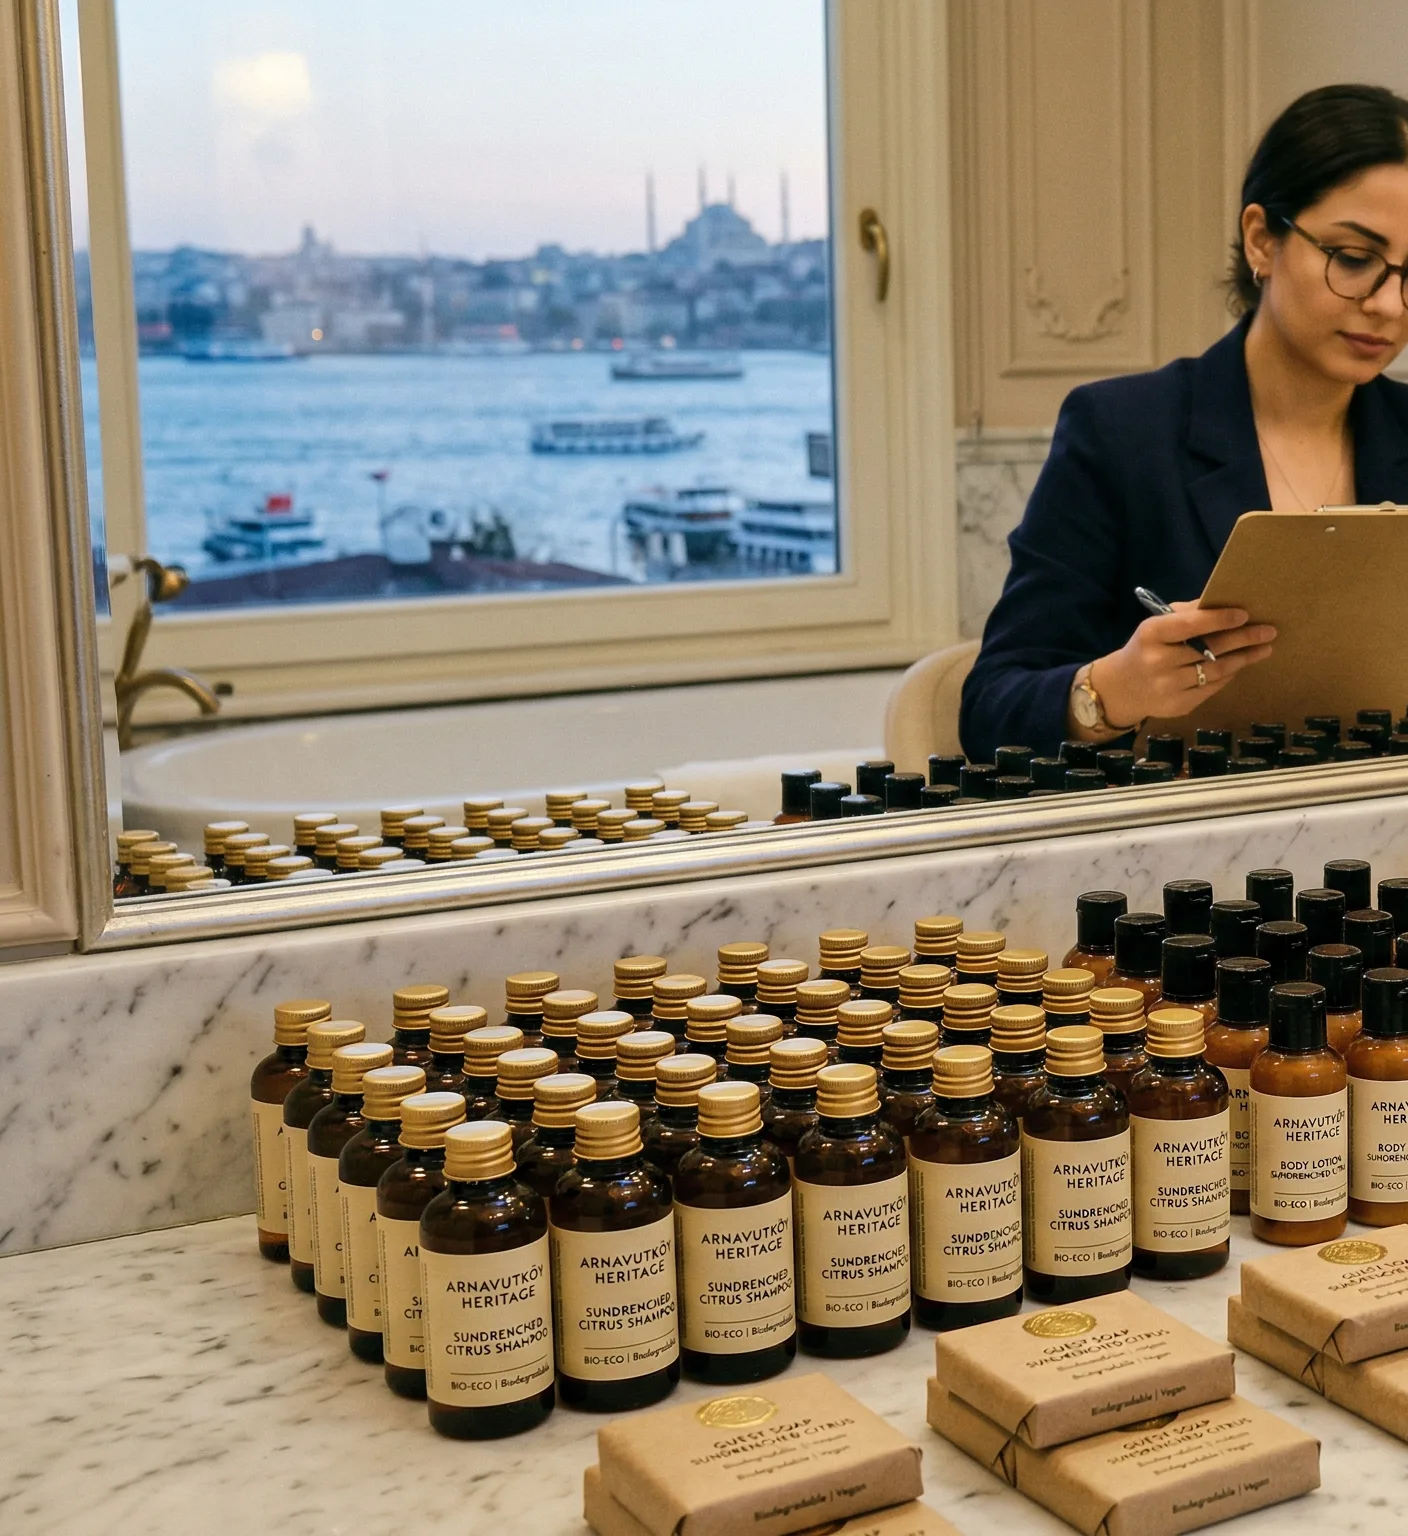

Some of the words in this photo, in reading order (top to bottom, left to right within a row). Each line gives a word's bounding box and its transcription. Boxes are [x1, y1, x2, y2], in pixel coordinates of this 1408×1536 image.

[1286, 1125, 1340, 1141] HERITAGE
[1166, 1148, 1223, 1167] HERITAGE
[1280, 1161, 1309, 1170] BODY
[1312, 1155, 1342, 1169] LOTION
[1067, 1168, 1125, 1189] HERITAGE
[960, 1190, 1017, 1213] HERITAGE
[1150, 1198, 1188, 1208] CITRUS
[1273, 1200, 1307, 1209] BIO-ECO
[837, 1213, 901, 1236] HERITAGE
[1049, 1220, 1090, 1231] CITRUS
[701, 1218, 789, 1245] ARNAVUTKÖY
[1153, 1230, 1188, 1239] BIO-ECO
[580, 1240, 671, 1269] ARNAVUTKÖY
[716, 1237, 783, 1260] HERITAGE
[943, 1245, 985, 1256] CITRUS
[1054, 1253, 1090, 1262] BIO-ECO
[595, 1259, 665, 1284] HERITAGE
[821, 1269, 864, 1280] CITRUS
[947, 1278, 984, 1288] BIO-ECO
[462, 1285, 535, 1308] HERITAGE
[699, 1294, 742, 1306] CITRUS
[825, 1303, 863, 1312] BIO-ECO
[453, 1317, 543, 1343] SUNDRENCHED
[578, 1319, 623, 1331] CITRUS
[704, 1328, 743, 1339] BIO-ECO
[1125, 1329, 1170, 1344] CITRUS
[445, 1345, 491, 1356] CITRUS
[584, 1355, 624, 1365] BIO-ECO
[451, 1381, 492, 1391] BIO-ECO
[1160, 1385, 1186, 1397] Vegan
[804, 1417, 855, 1434] CITRUS
[714, 1430, 765, 1449] GUEST
